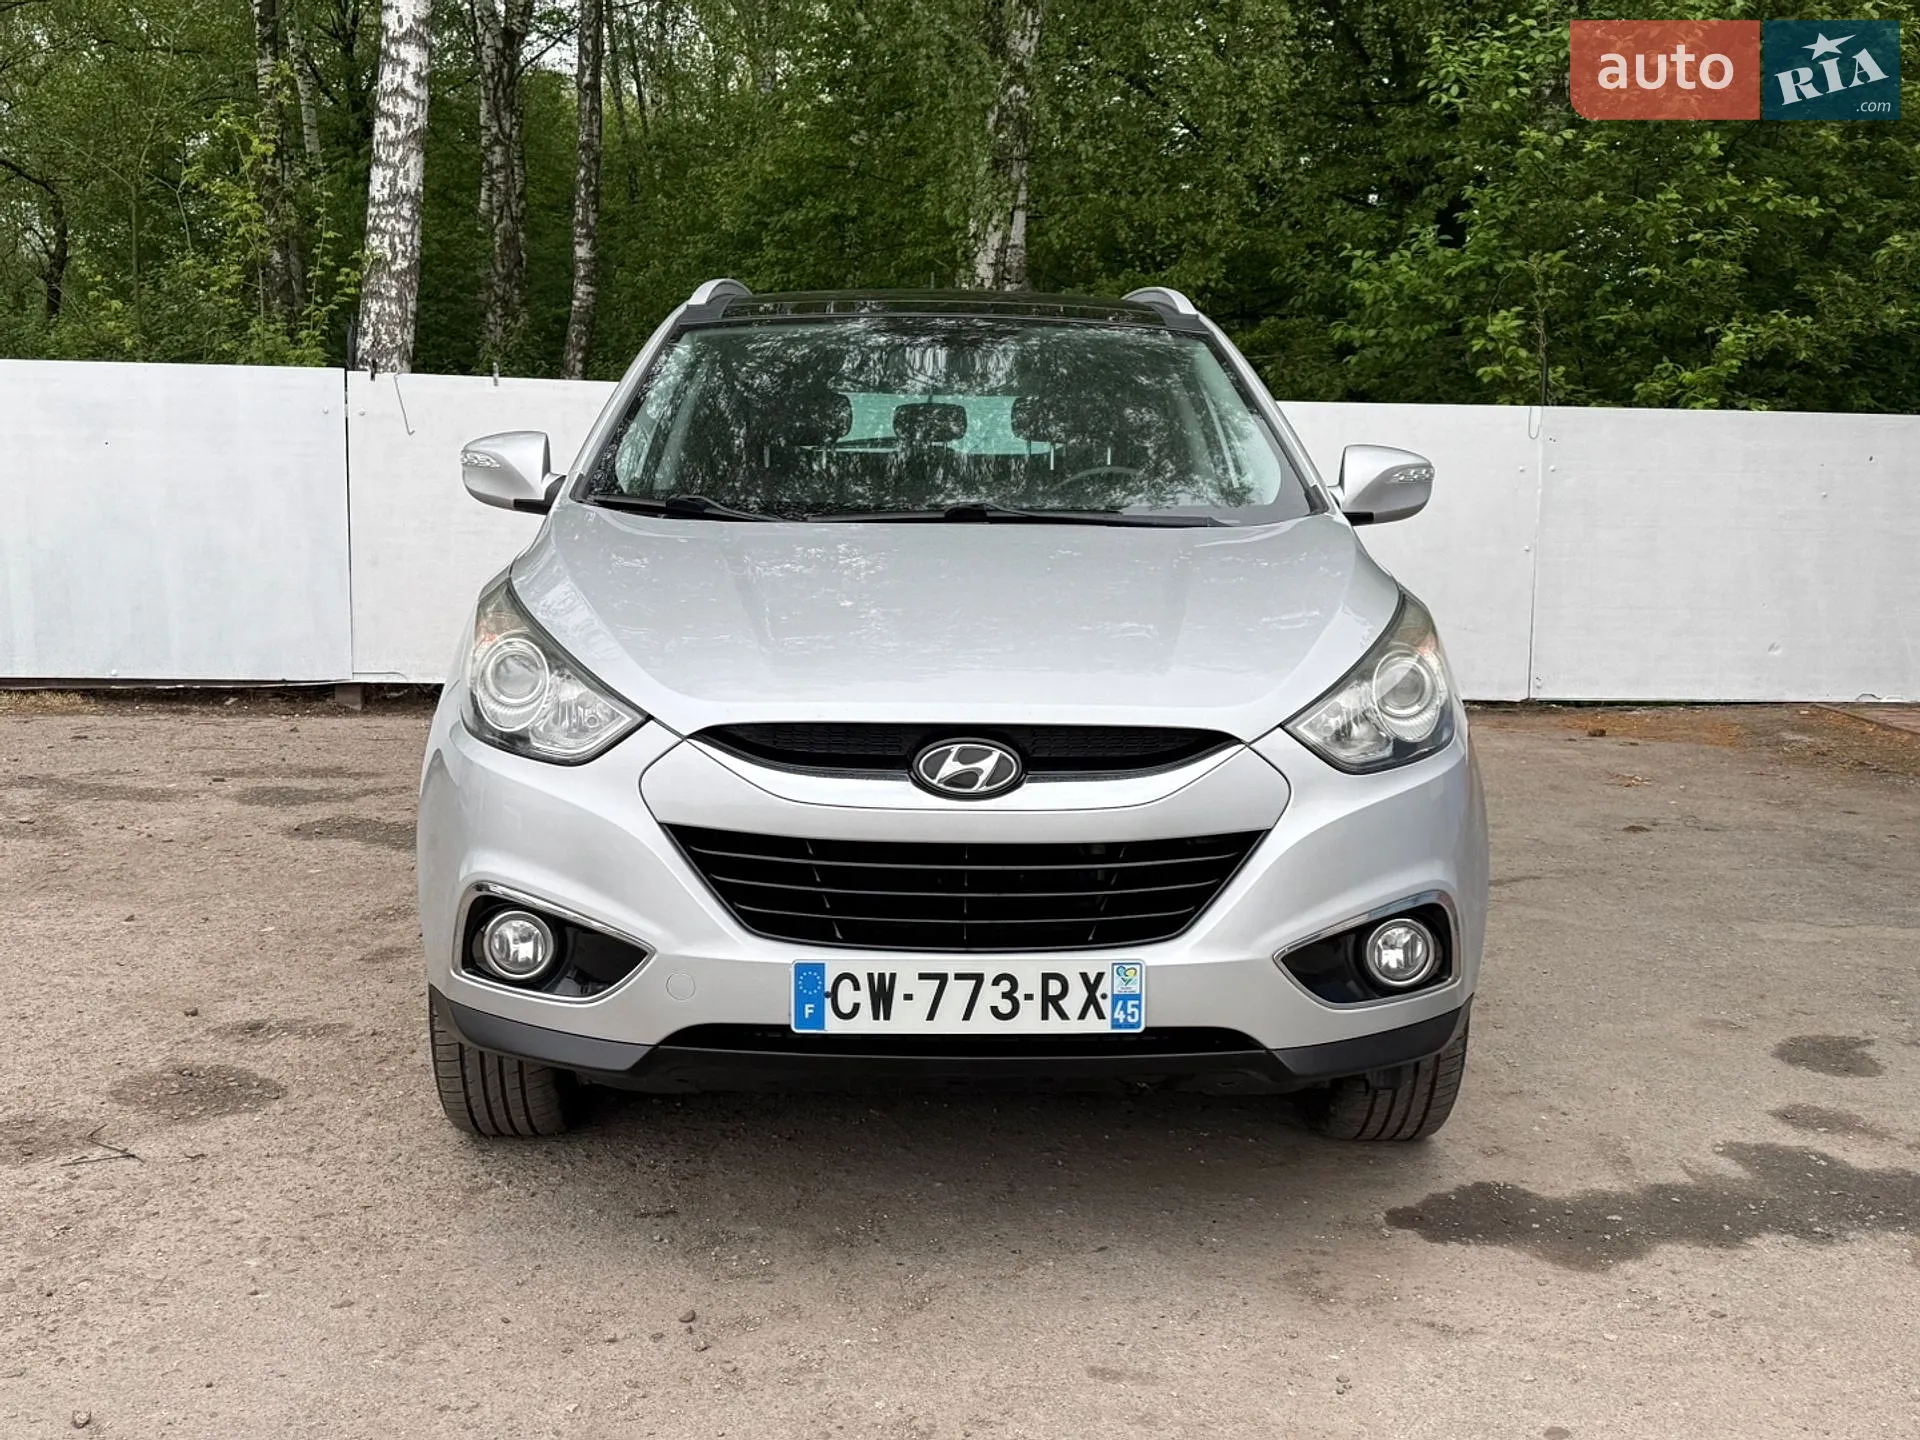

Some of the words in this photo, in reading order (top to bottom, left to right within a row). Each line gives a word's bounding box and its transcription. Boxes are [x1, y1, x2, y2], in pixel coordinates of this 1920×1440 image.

[830, 971, 1106, 1021] CW-773-RX
[804, 1003, 815, 1019] F
[1113, 1000, 1140, 1023] 45
